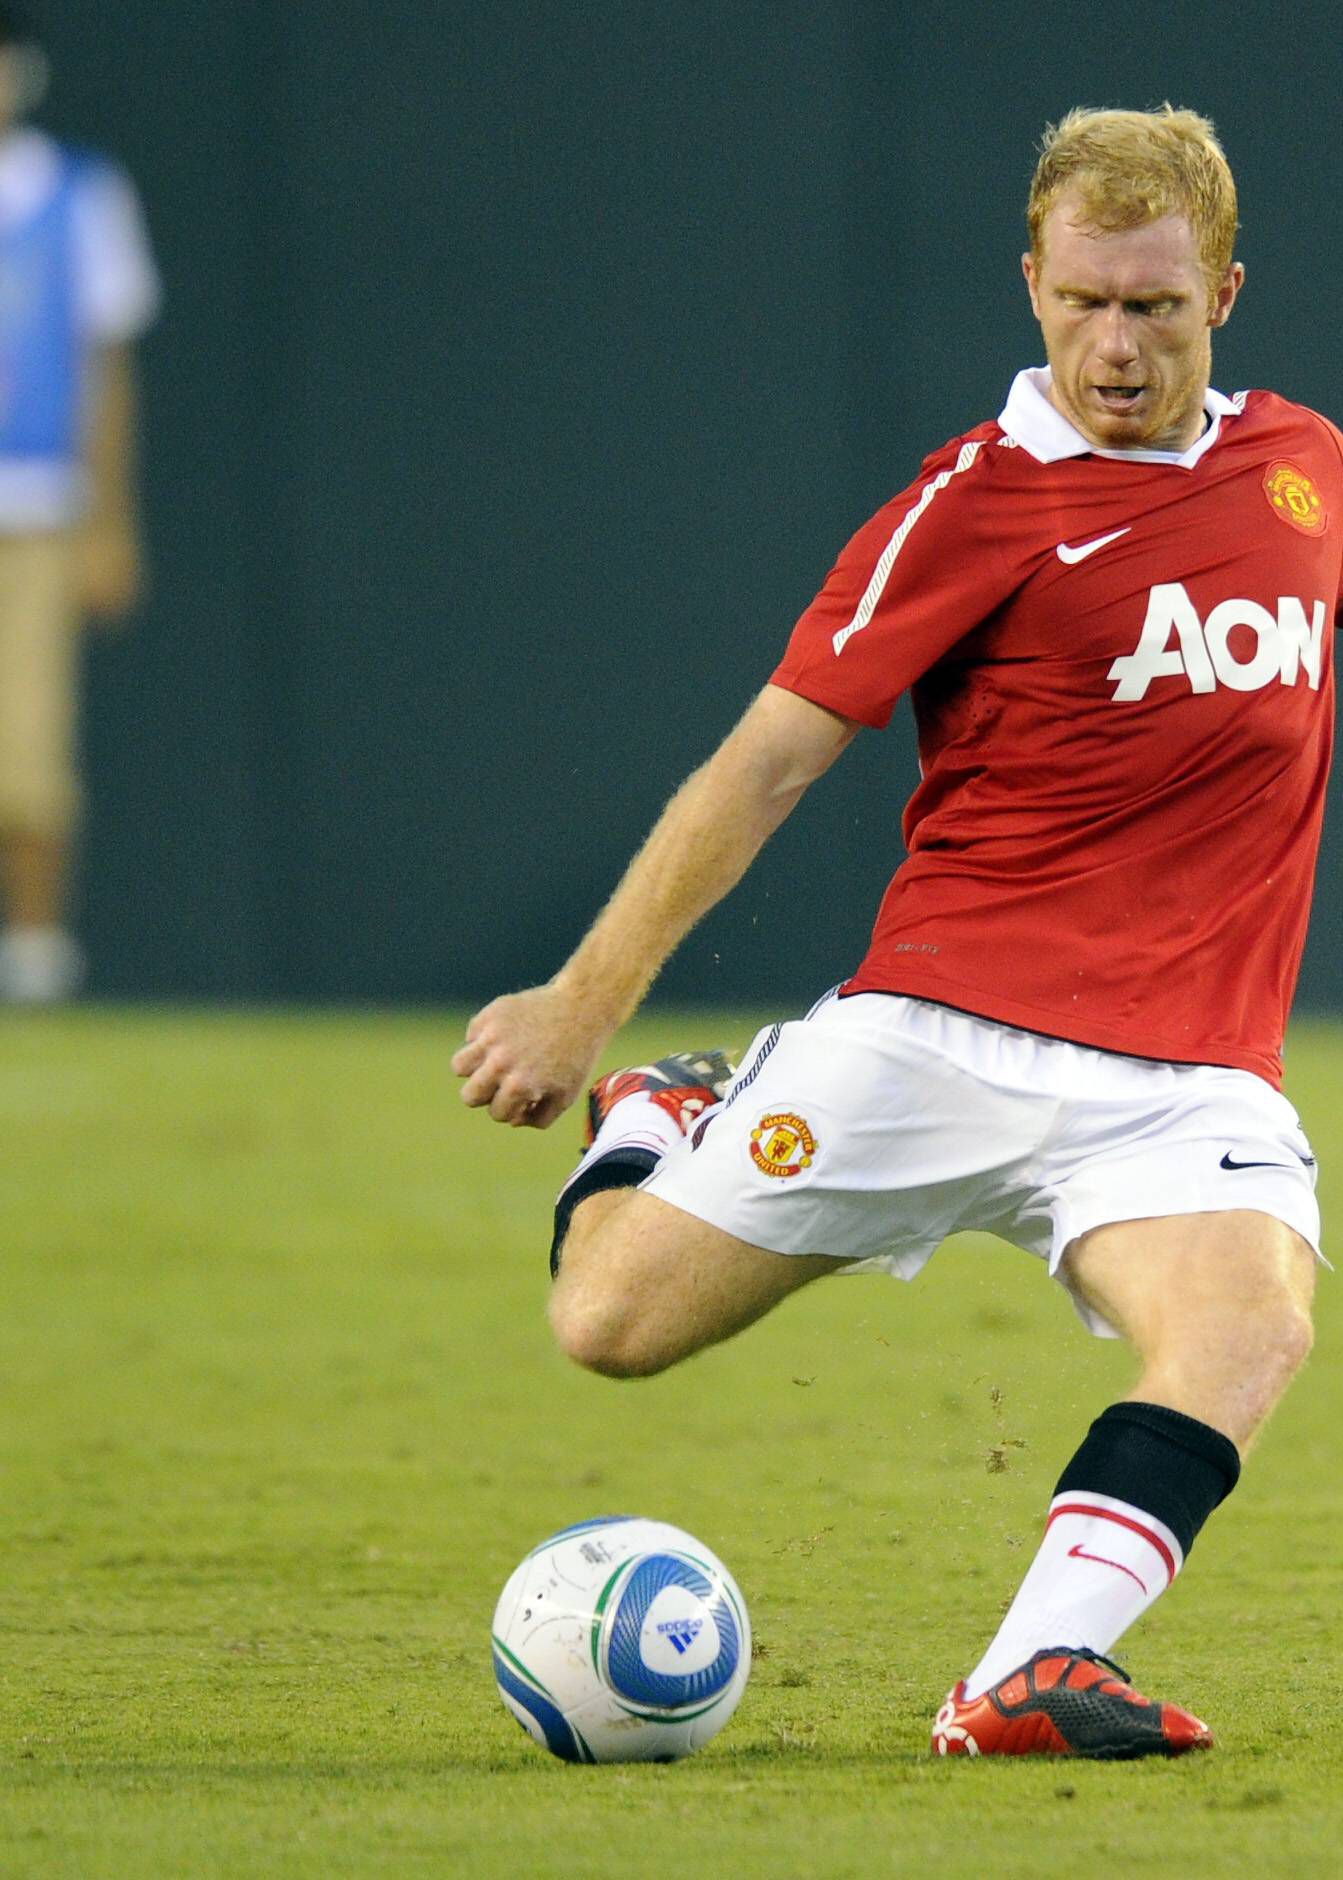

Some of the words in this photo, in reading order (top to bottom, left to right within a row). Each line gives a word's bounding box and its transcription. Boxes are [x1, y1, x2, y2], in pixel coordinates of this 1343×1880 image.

[1107, 582, 1326, 701] AON
[764, 1116, 812, 1151] MANCHESTER
[753, 1152, 789, 1175] UNITED
